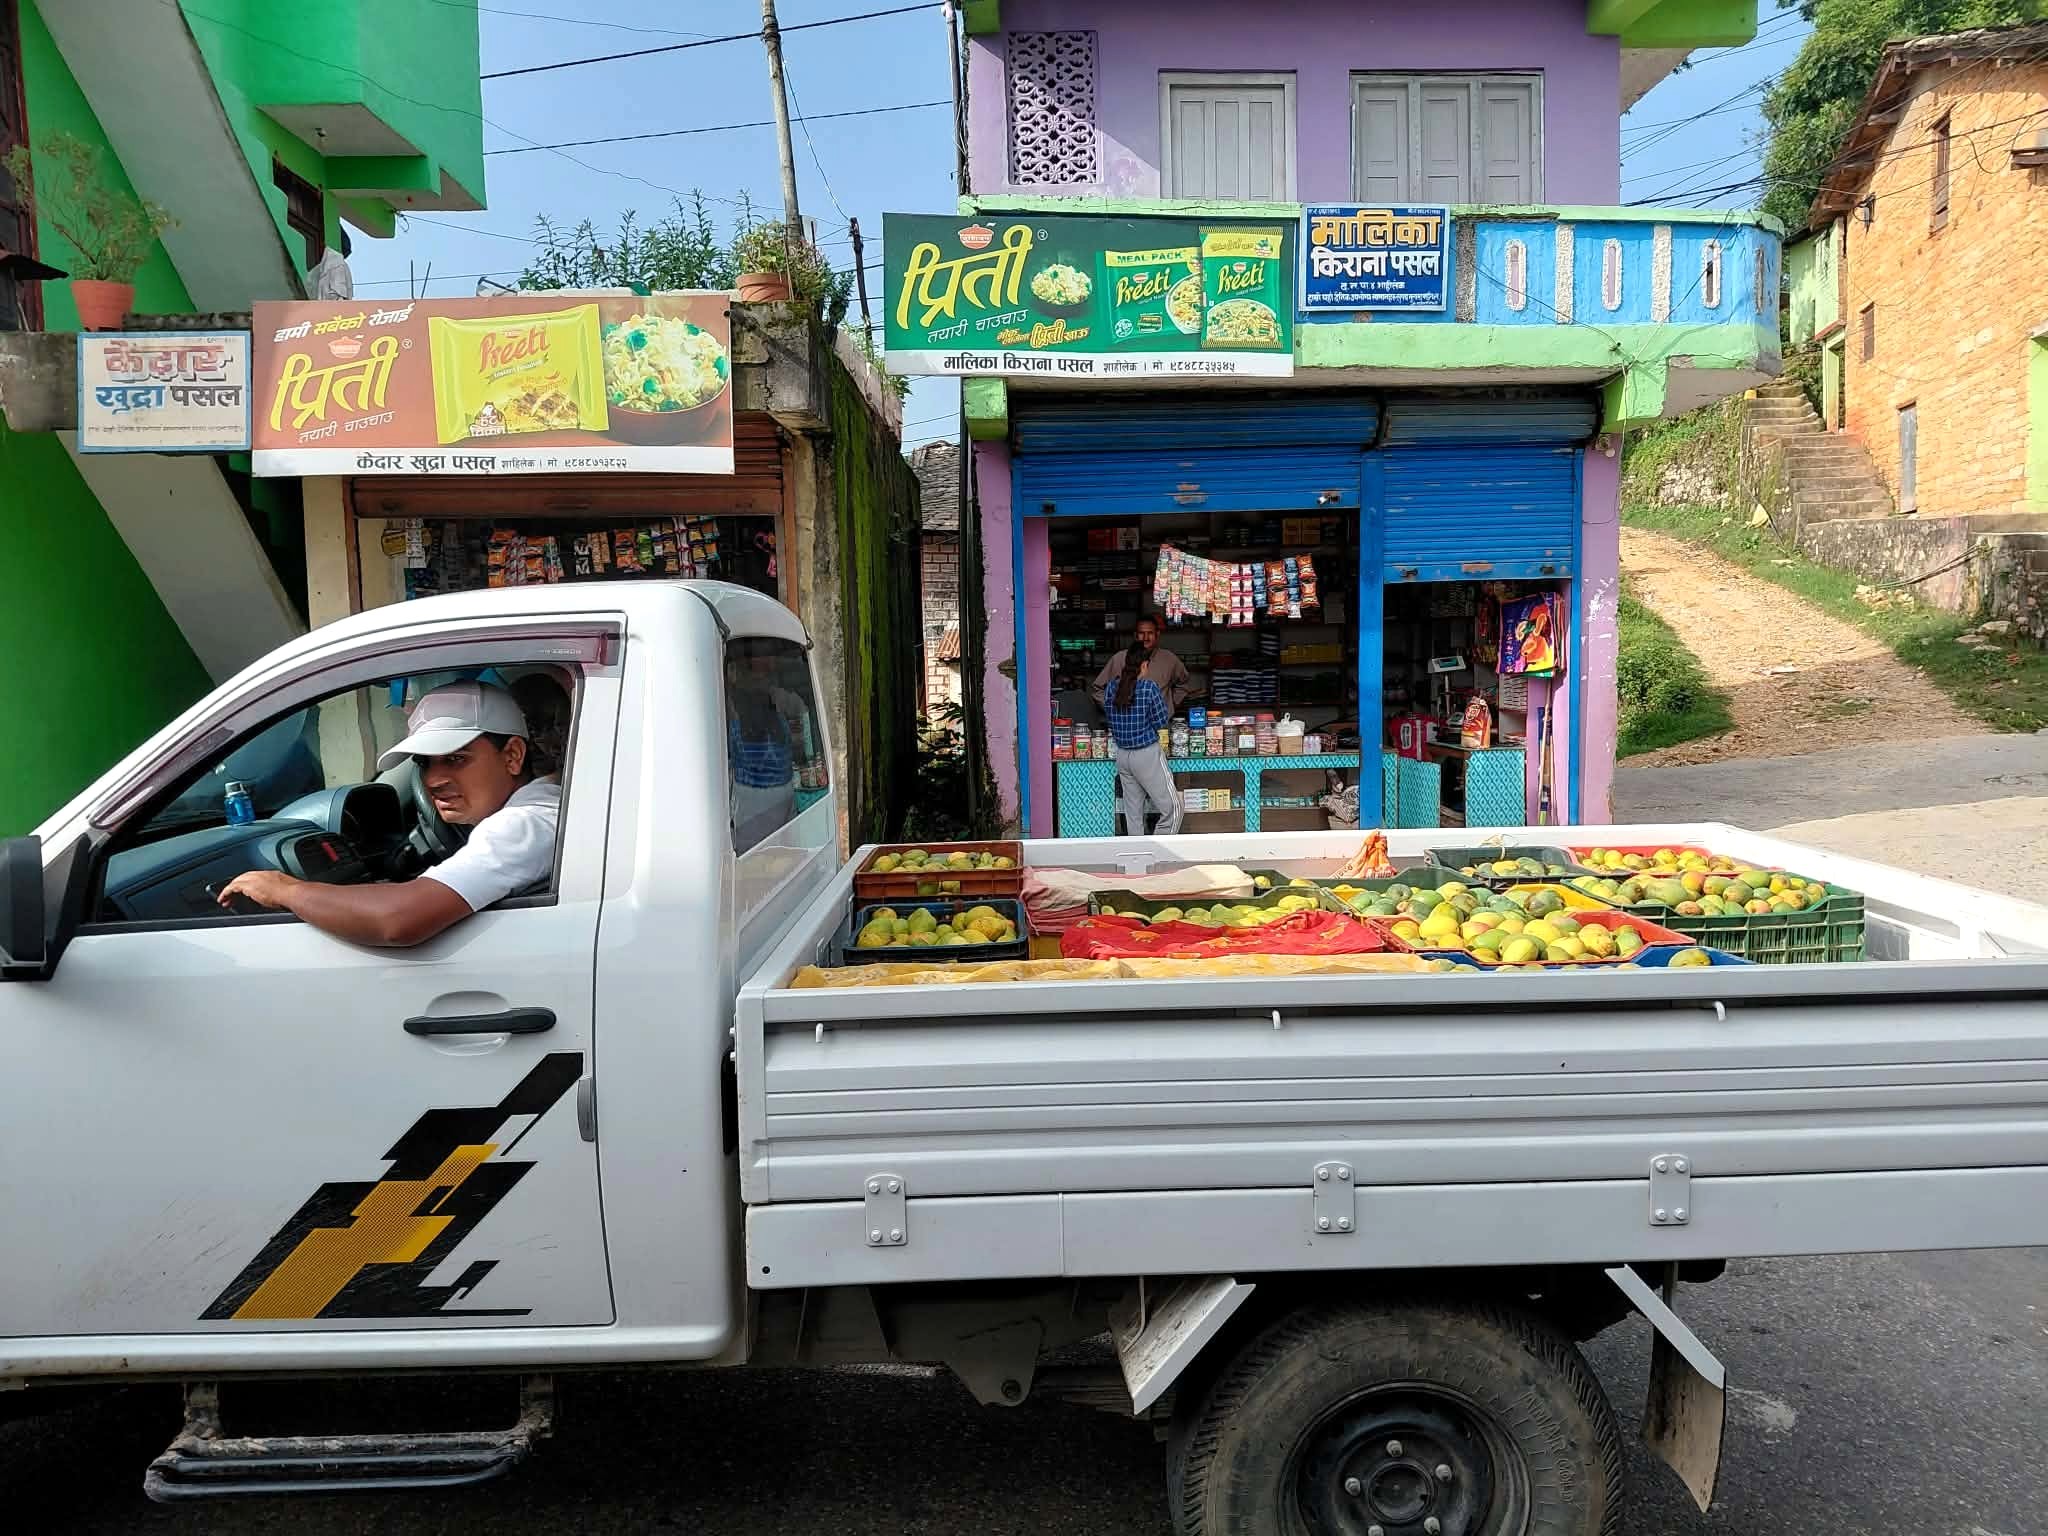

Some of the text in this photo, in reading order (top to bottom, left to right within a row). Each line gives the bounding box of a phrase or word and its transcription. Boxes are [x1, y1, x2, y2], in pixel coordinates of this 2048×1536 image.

[1311, 209, 1442, 247] मालिका
[1117, 251, 1184, 264] MEAL PACK
[1311, 246, 1441, 277] किराना पसल
[896, 224, 1033, 329] प्रिती
[1115, 267, 1173, 307] Preeti
[1217, 260, 1265, 295] Preeti
[273, 321, 312, 343] हामी
[368, 303, 415, 327] रोजाई
[927, 318, 968, 344] तयारी
[975, 309, 1029, 332] चाउचाउ
[104, 340, 233, 382] केदार
[479, 321, 551, 374] Preeti
[943, 352, 999, 370] मालिका
[1003, 352, 1053, 371] किराना
[1057, 358, 1094, 373] पसल
[95, 385, 242, 415] खुद्रा पसल
[270, 336, 399, 431] प्रिती
[298, 411, 395, 444] तयारी चाउचाउ
[356, 452, 404, 470] केदार
[409, 455, 446, 472] खुद्रा
[452, 455, 496, 471] पसल
